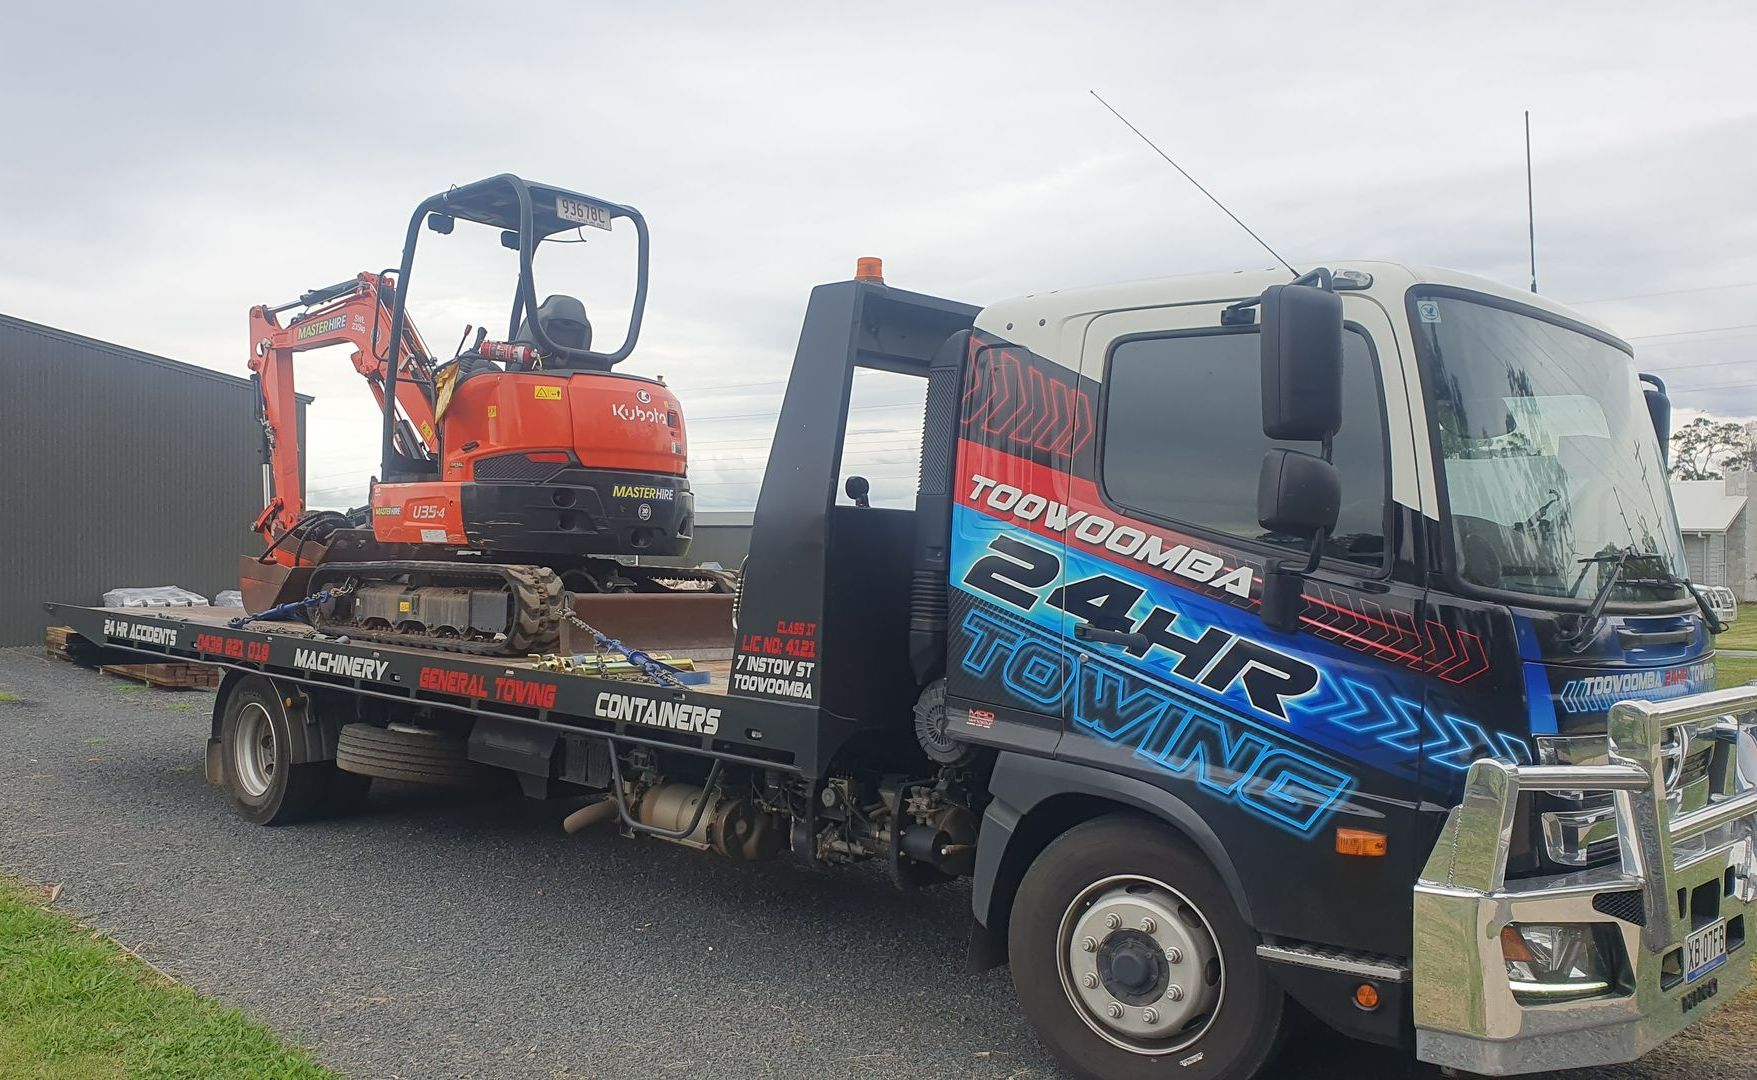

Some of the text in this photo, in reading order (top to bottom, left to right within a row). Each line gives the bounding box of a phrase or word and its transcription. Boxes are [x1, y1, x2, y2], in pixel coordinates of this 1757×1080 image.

[562, 199, 605, 223] 93678C
[297, 315, 347, 340] MASTERHIRE
[612, 403, 667, 425] Kubota
[612, 485, 674, 501] MASTERHIRE
[968, 474, 1253, 598] TOOWOOMBA
[103, 619, 178, 646] 24 HR ACCIDENTS
[777, 620, 805, 636] CLASS
[962, 534, 1321, 722] 24HR
[785, 639, 816, 658] 4121
[293, 648, 390, 681] MACHINERY
[736, 654, 815, 679] 7 INSTOW ST
[418, 666, 558, 709] GENERAL TOWING
[734, 673, 812, 699] TOOWOOMBA
[1585, 669, 1663, 696] TOOWOOMBA
[594, 692, 722, 736] CONTAINERS
[960, 608, 1355, 833] TOWING
